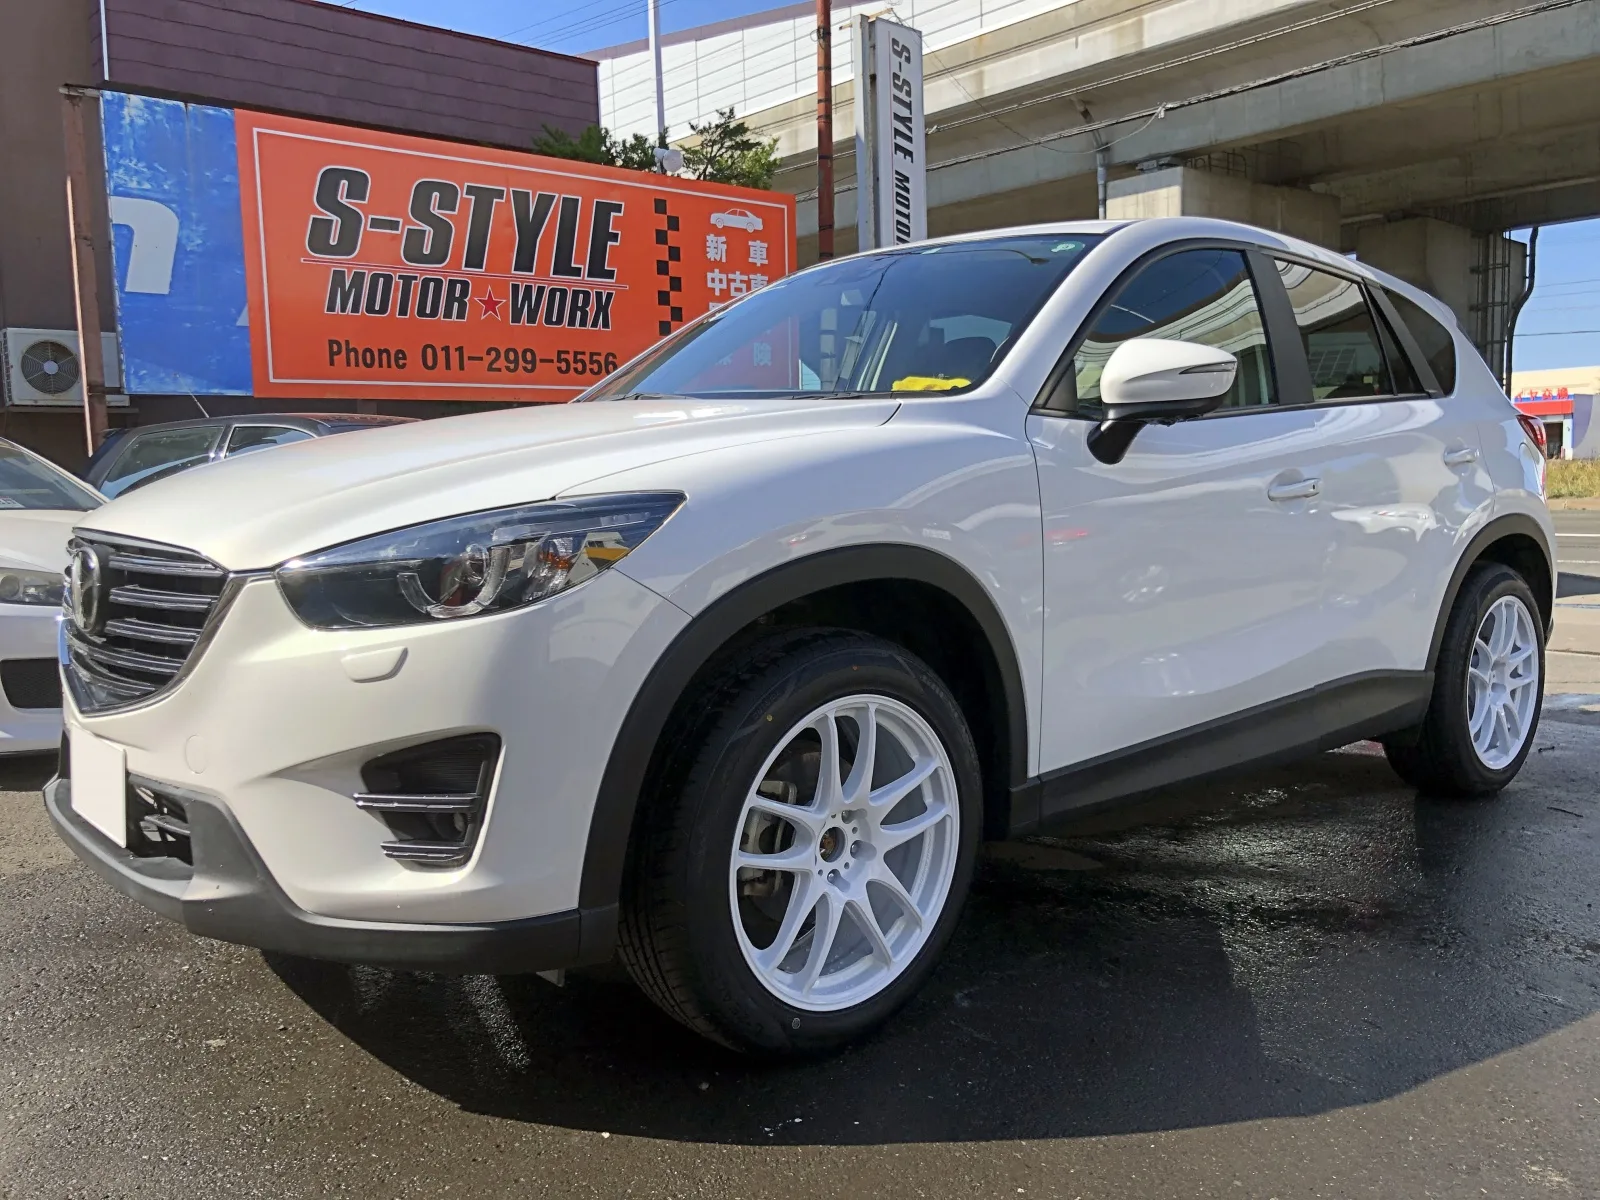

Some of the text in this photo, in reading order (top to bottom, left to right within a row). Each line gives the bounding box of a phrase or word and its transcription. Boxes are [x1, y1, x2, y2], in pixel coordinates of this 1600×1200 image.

[891, 37, 914, 164] S-STYLE
[305, 165, 625, 282] S-STYLE
[325, 268, 616, 331] MOTOR WORX
[327, 338, 619, 376] Phone 011-299-5556
